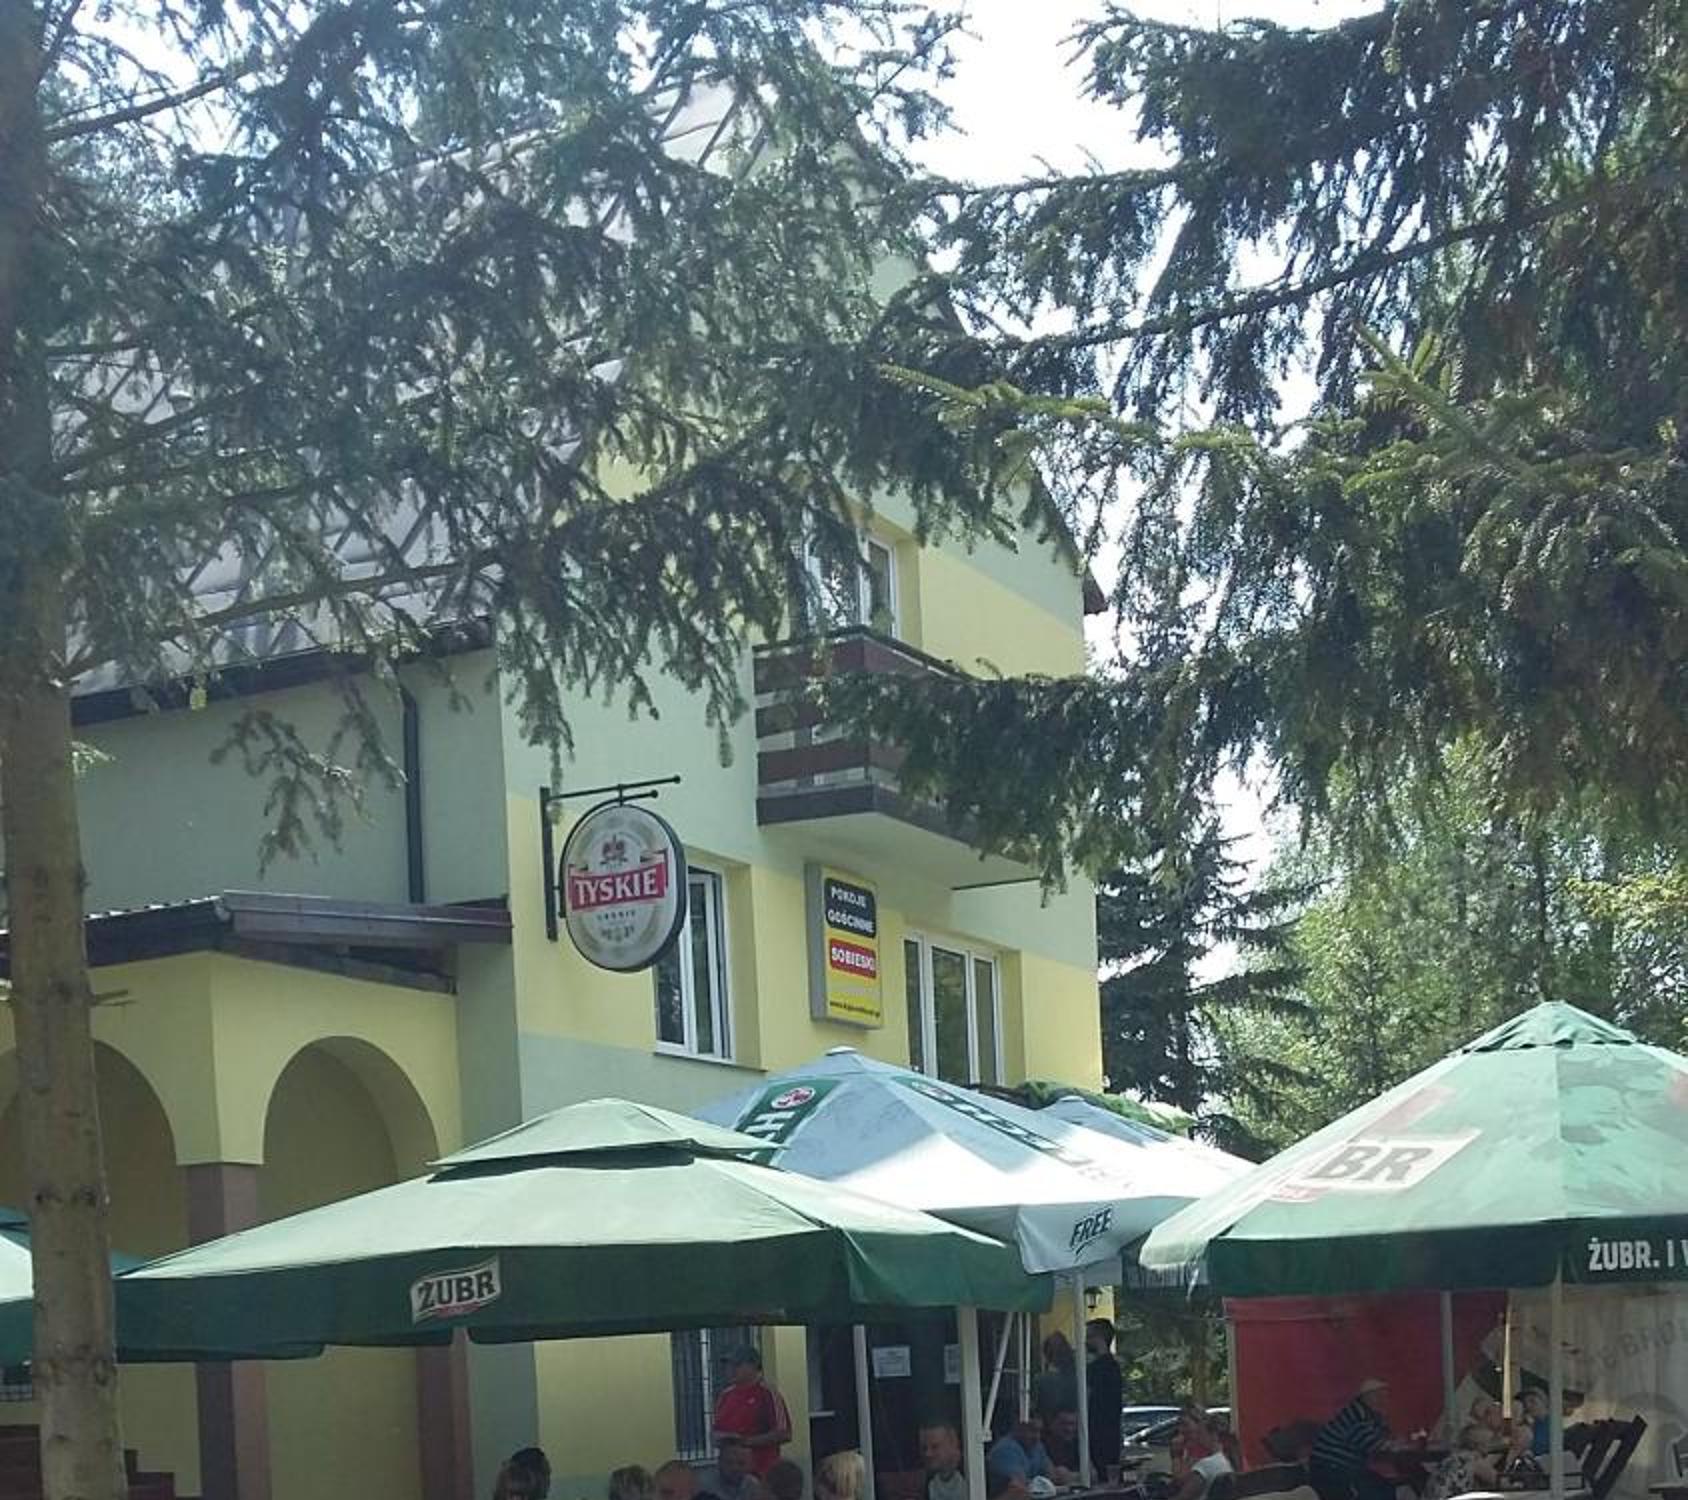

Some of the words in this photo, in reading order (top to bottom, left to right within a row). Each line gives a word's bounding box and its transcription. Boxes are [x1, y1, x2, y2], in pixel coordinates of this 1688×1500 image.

[574, 868, 659, 906] TYSKIE
[831, 946, 876, 971] SOBIESKI
[1069, 1206, 1113, 1249] FREE
[1588, 1237, 1660, 1271] ŻUBR.
